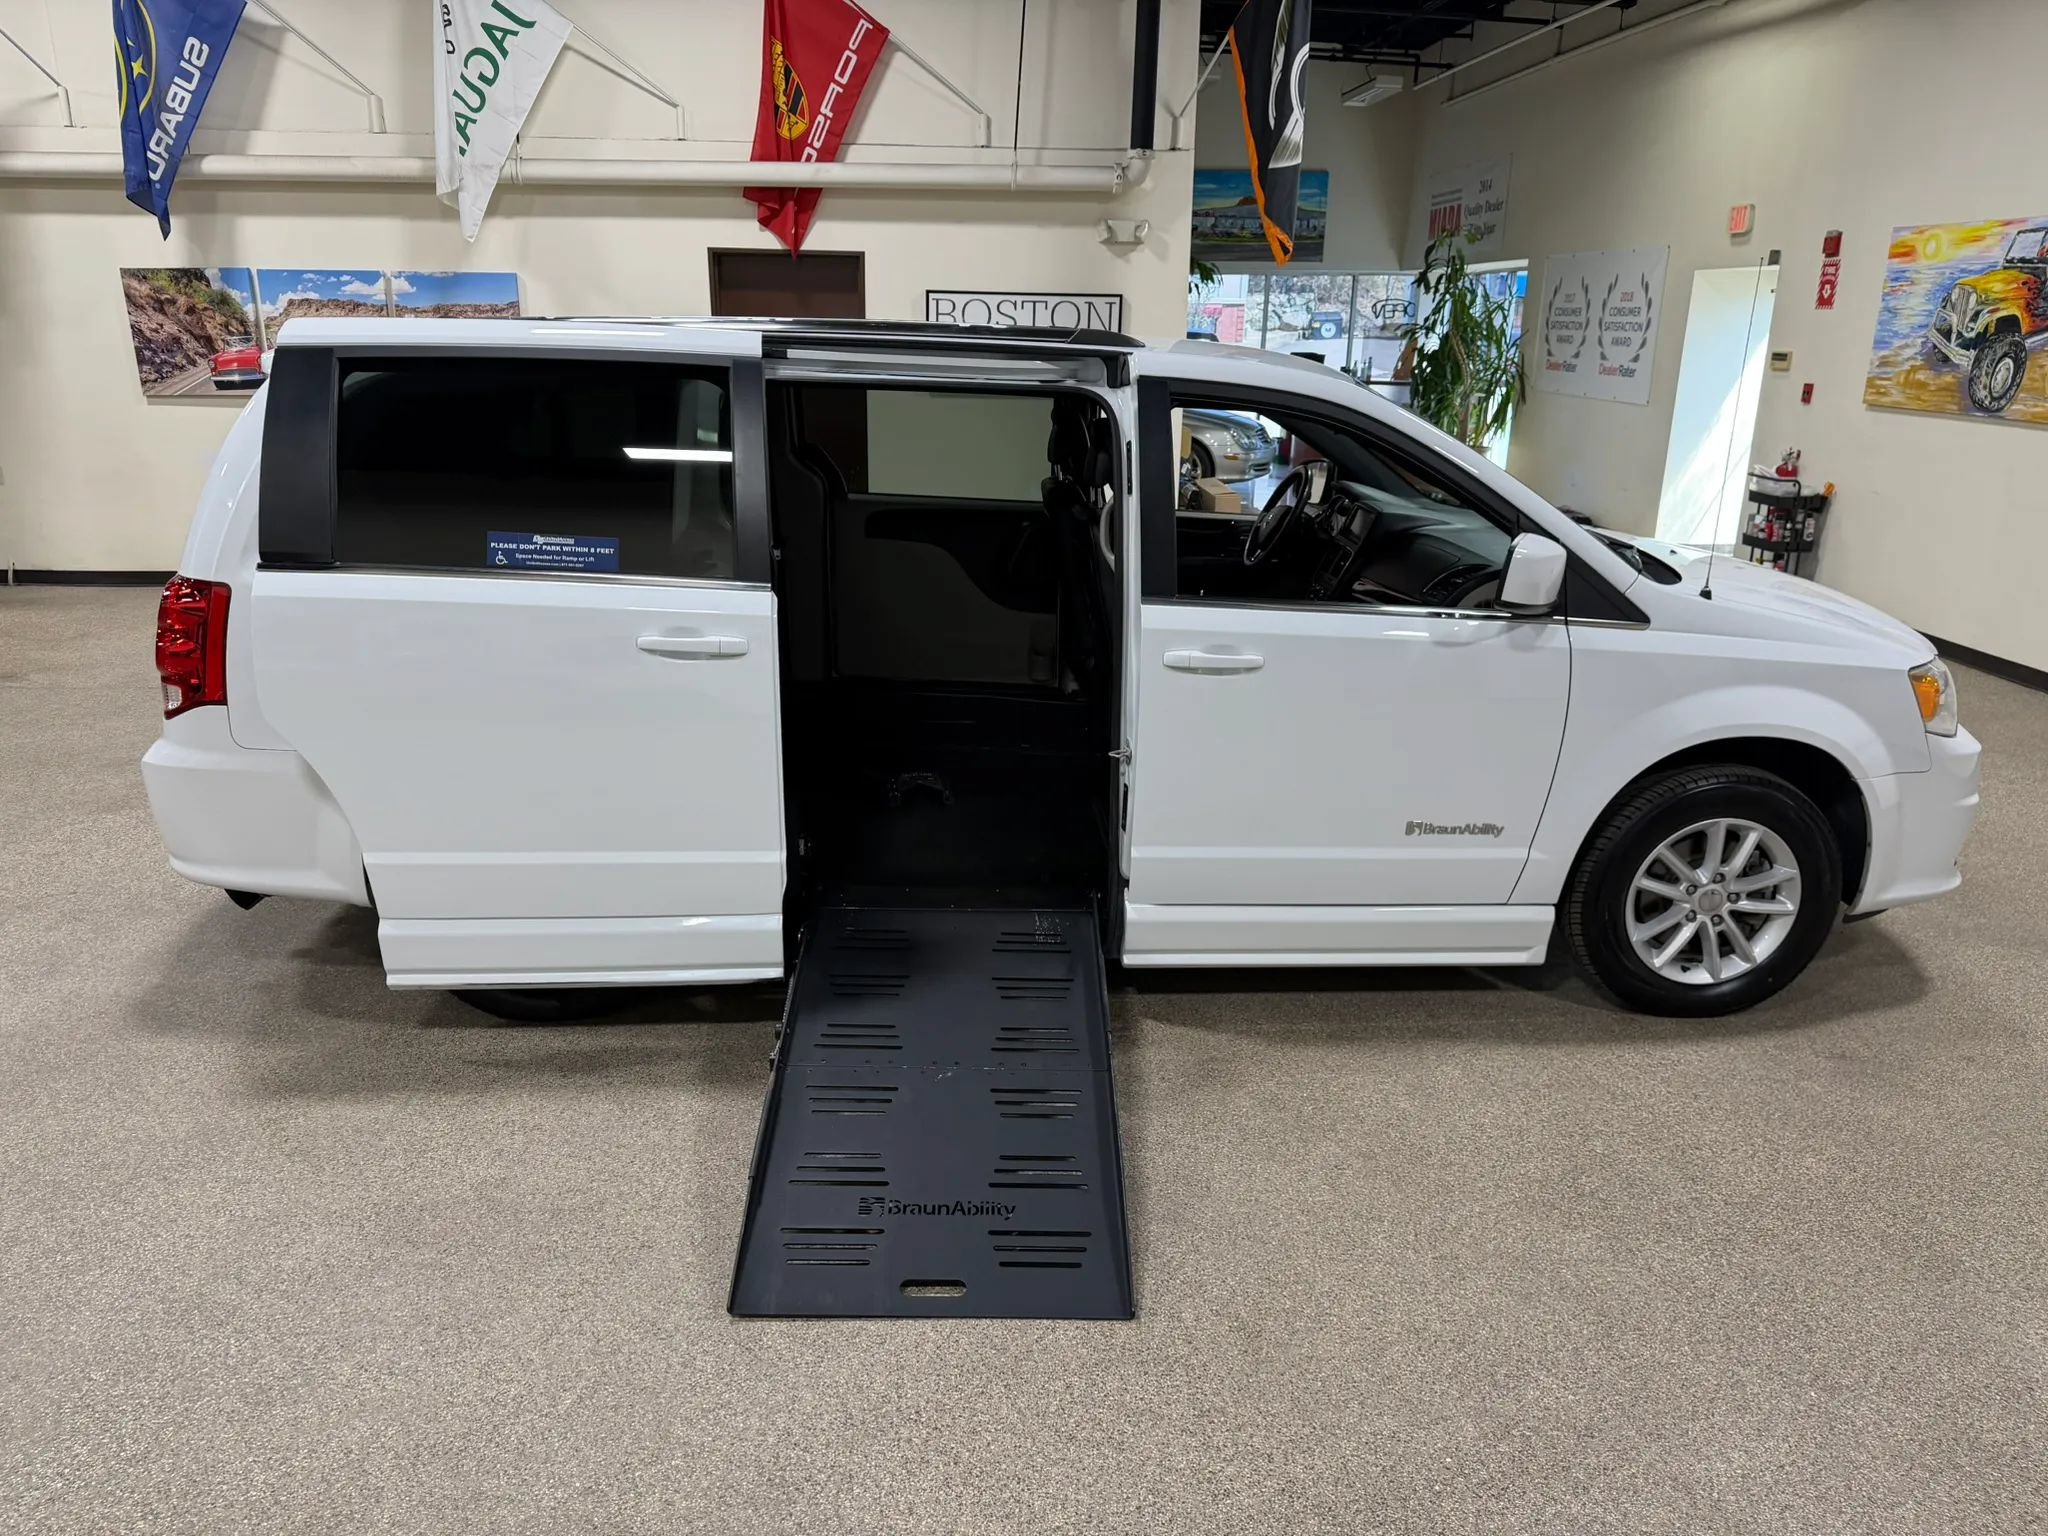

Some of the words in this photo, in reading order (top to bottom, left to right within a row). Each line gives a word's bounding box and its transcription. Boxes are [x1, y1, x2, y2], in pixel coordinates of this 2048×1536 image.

[1484, 198, 1504, 214] Dealer
[931, 297, 1117, 331] BOSTON
[1554, 307, 1582, 317] CONSUMER
[1609, 306, 1641, 317] CONSUMER
[1550, 320, 1583, 331] SATISFACTION
[1603, 321, 1644, 333] SATISFACTION
[1611, 336, 1632, 348] AWARD
[1423, 822, 1504, 838] BraunAbility
[887, 1199, 1016, 1221] BraunAbility
